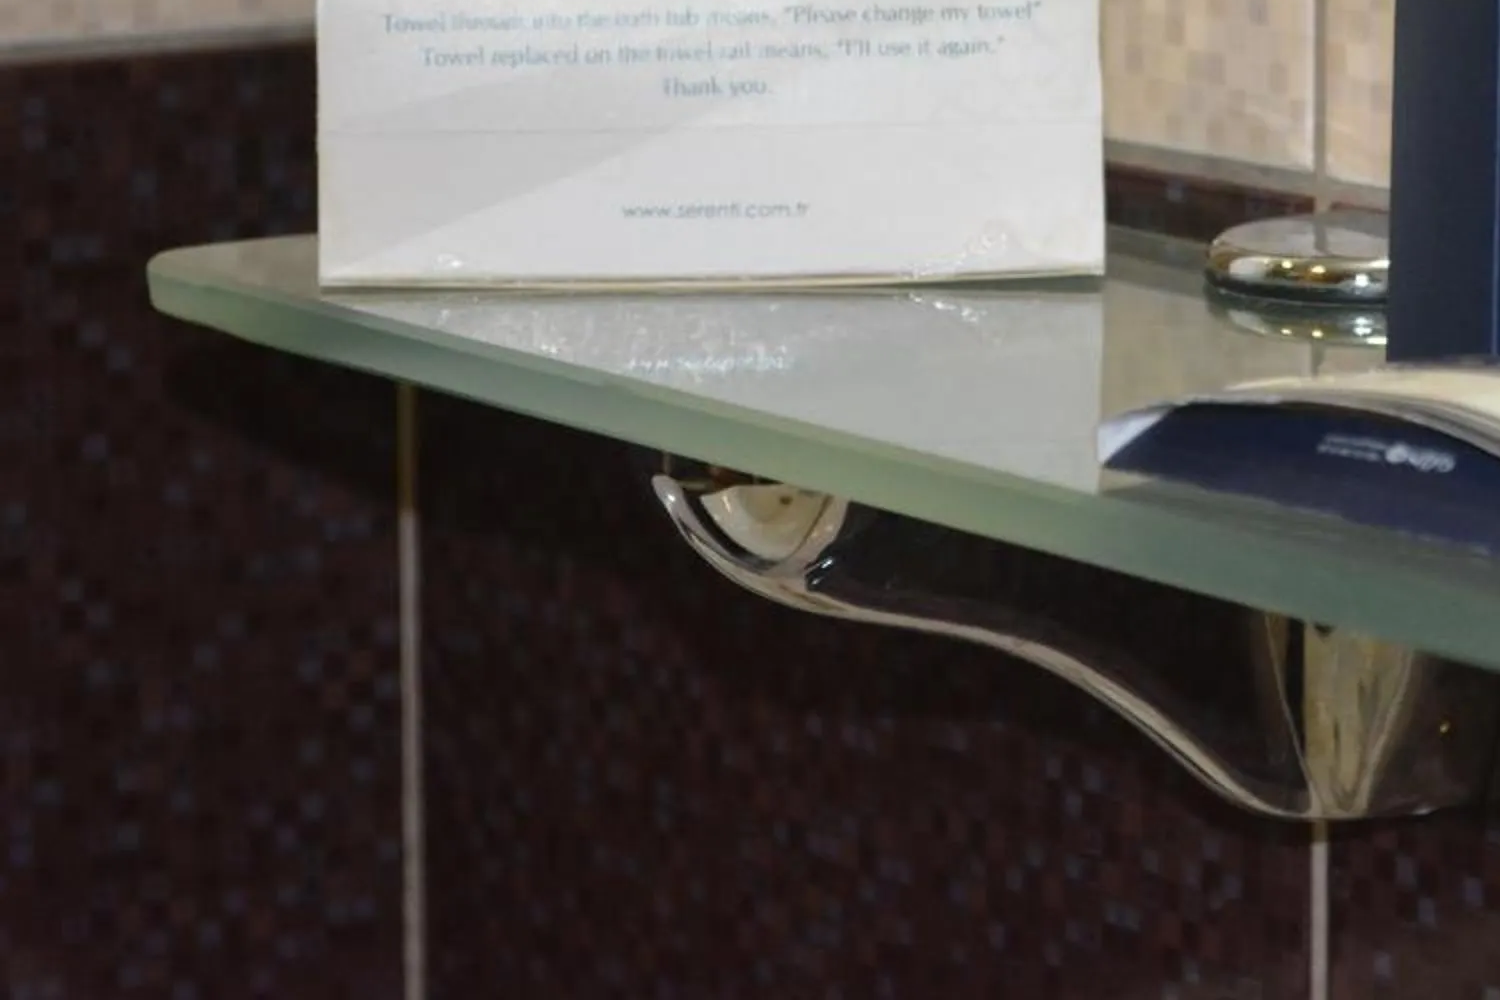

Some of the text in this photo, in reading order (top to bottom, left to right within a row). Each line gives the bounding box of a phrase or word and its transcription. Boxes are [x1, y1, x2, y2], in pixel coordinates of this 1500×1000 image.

[861, 2, 936, 25] change
[940, 5, 969, 23] my
[421, 45, 486, 68] Towel
[489, 42, 579, 69] replaced
[584, 47, 612, 66] on
[617, 43, 652, 63] the
[877, 42, 912, 58] use
[917, 36, 934, 57] it
[662, 75, 723, 98] Thank
